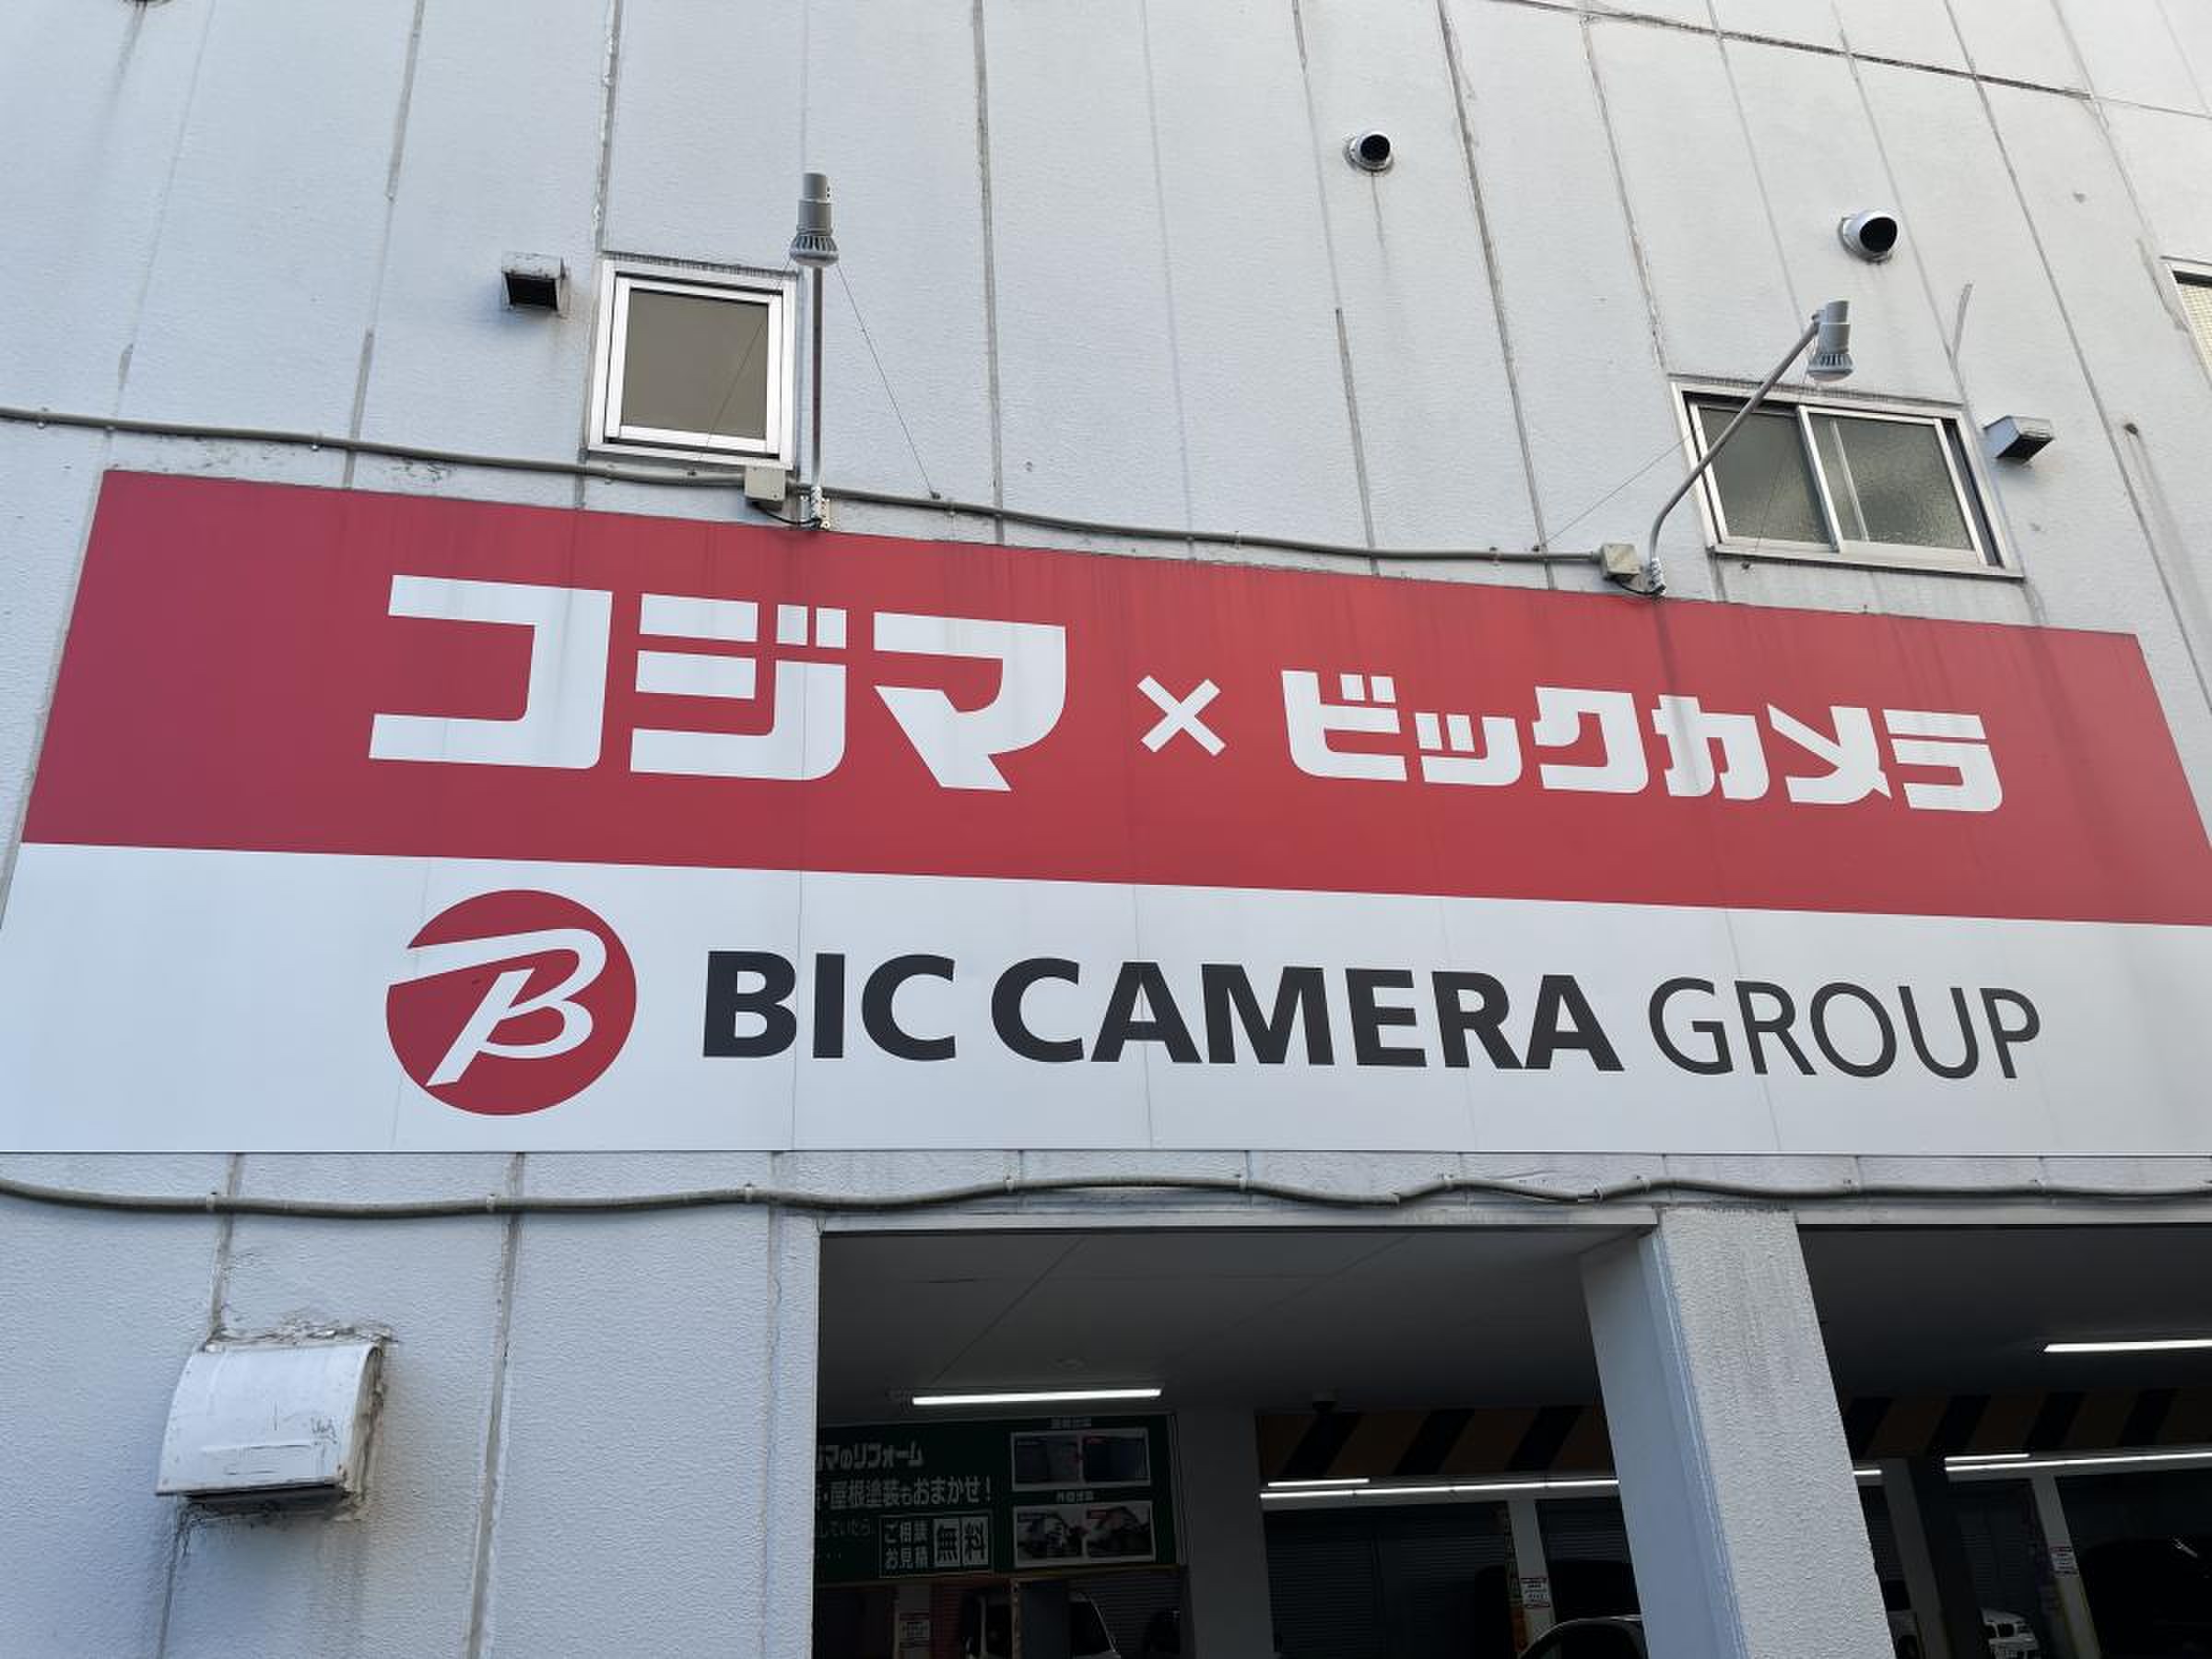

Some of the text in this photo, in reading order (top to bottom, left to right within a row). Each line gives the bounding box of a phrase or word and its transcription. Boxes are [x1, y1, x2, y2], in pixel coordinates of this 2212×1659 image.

[368, 574, 1066, 792] コジマ
[1281, 669, 2003, 812] ビックカメラ
[703, 950, 2040, 1079] BIC CAMERA GROUP
